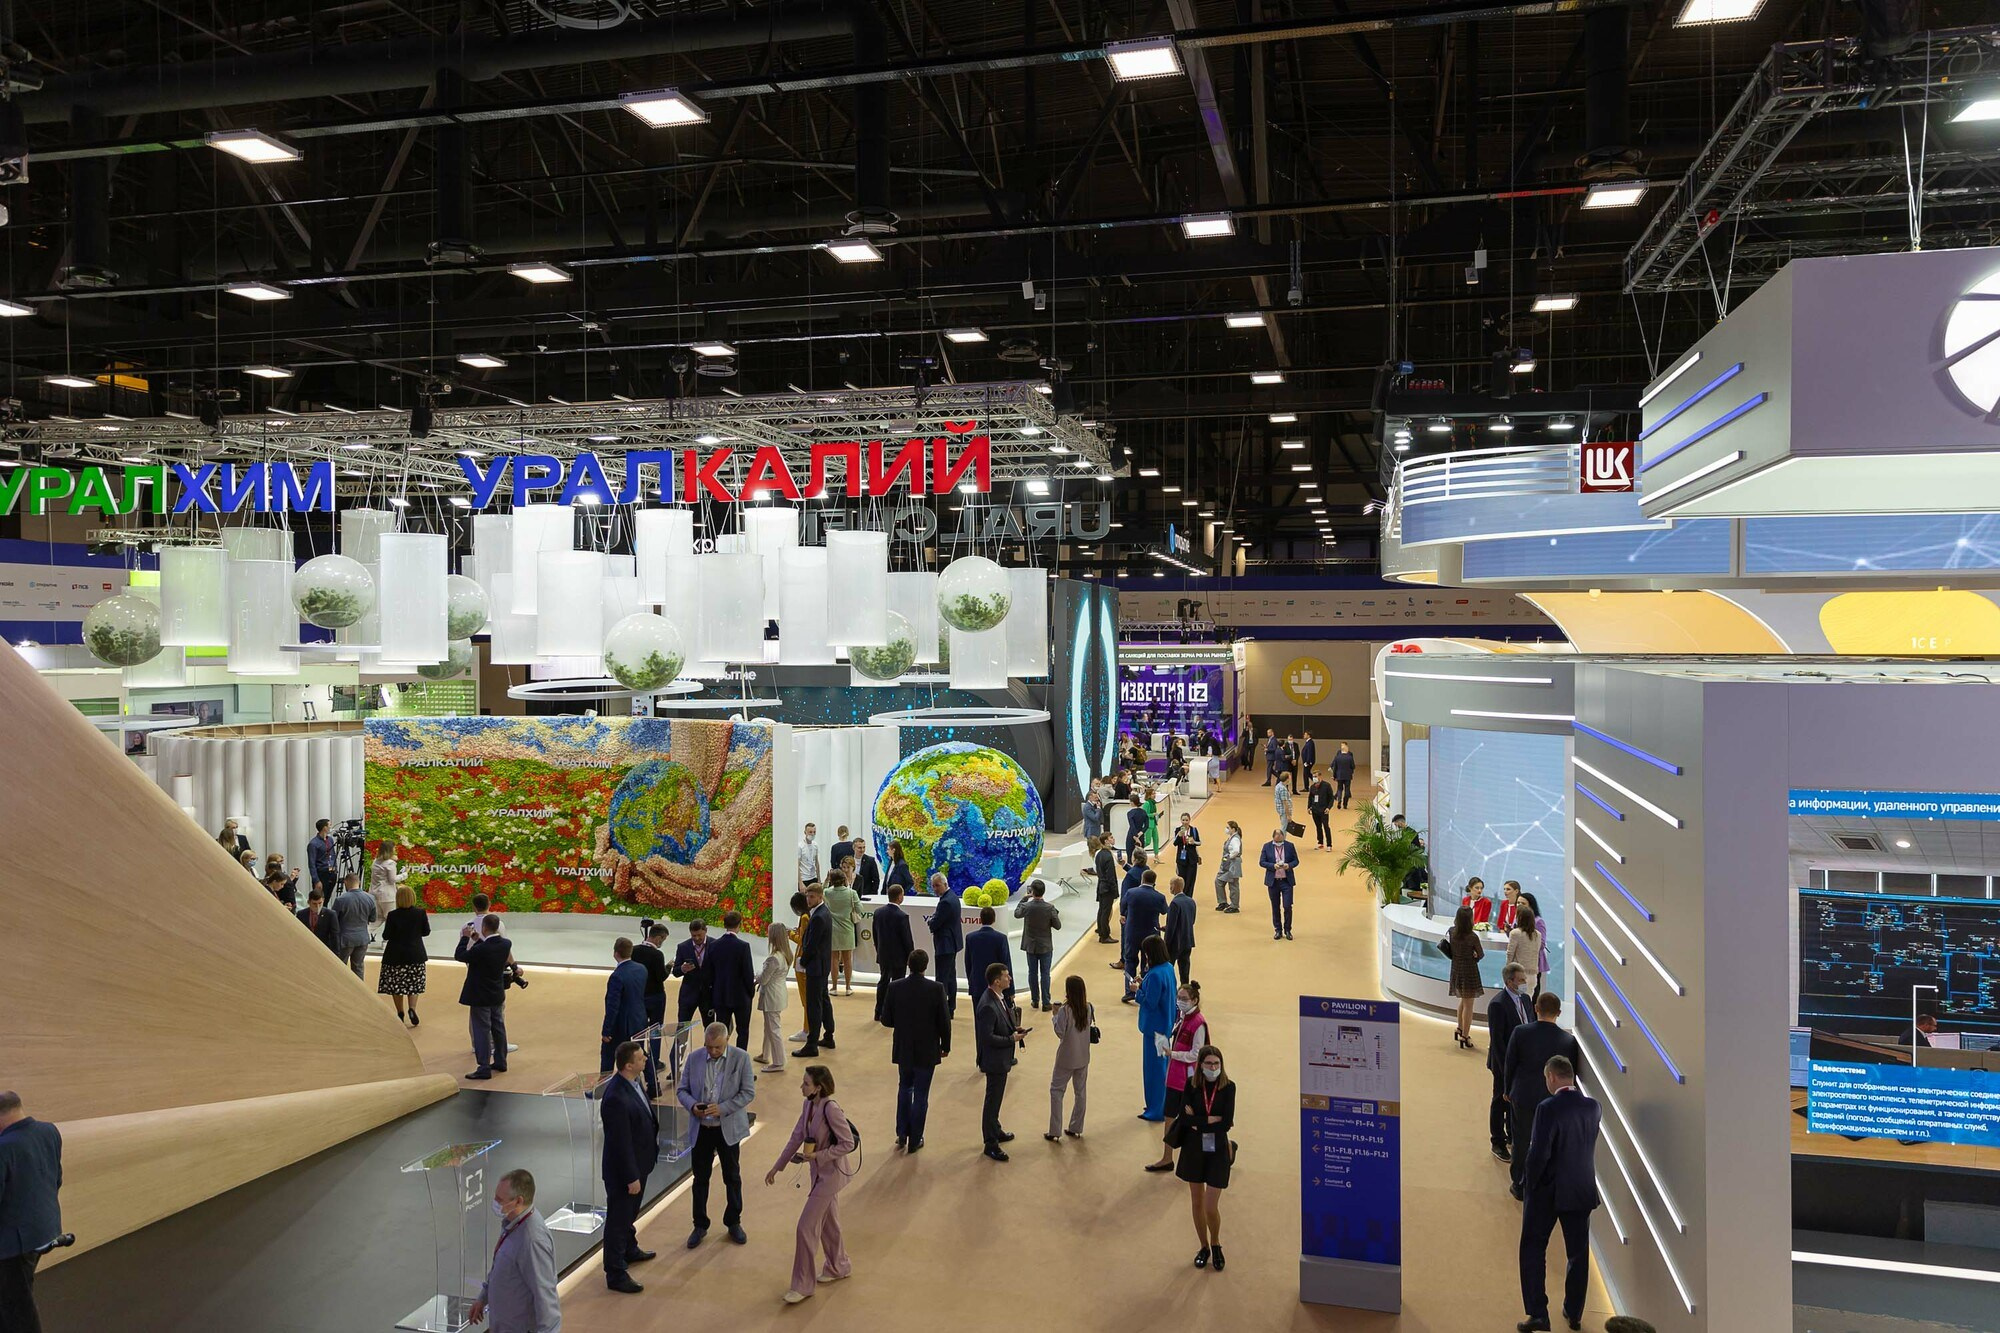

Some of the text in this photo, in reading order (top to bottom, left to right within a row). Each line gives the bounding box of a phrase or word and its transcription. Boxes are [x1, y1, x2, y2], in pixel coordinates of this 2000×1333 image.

[457, 420, 991, 508] УРАЛКАЛИЙ
[0, 462, 335, 515] УРАЛХИМ
[1121, 682, 1184, 701] ИЗВЕСТИЯ
[400, 756, 484, 767] УРАЛКАЛИЙ
[554, 758, 612, 769] УРАЛХИМ
[1798, 798, 1871, 812] информации,
[1874, 801, 1938, 812] удаленного
[490, 808, 553, 818] УРАЛХИМ
[986, 826, 1036, 839] УРАЛХИМ
[553, 867, 613, 877] УРАЛХИМ
[1332, 1002, 1366, 1010] PAVILION
[1812, 1064, 1866, 1075] Видеосистема
[1812, 1079, 1837, 1088] Служит
[1853, 1082, 1898, 1092] отображения
[1917, 1087, 1969, 1096] электрических
[1812, 1091, 1867, 1100] электросетевого
[1869, 1095, 1907, 1104] комплекса,
[1908, 1097, 1969, 1108] телеметрической
[1818, 1102, 1857, 1111] параметрах
[1868, 1105, 1936, 1117] функционирования,
[1943, 1111, 1965, 1119] также
[1812, 1112, 1989, 1132] сведений (погоды, сообщений оперативных служб,
[1812, 1122, 1882, 1133] геоинформационных
[1884, 1128, 1908, 1136] систем
